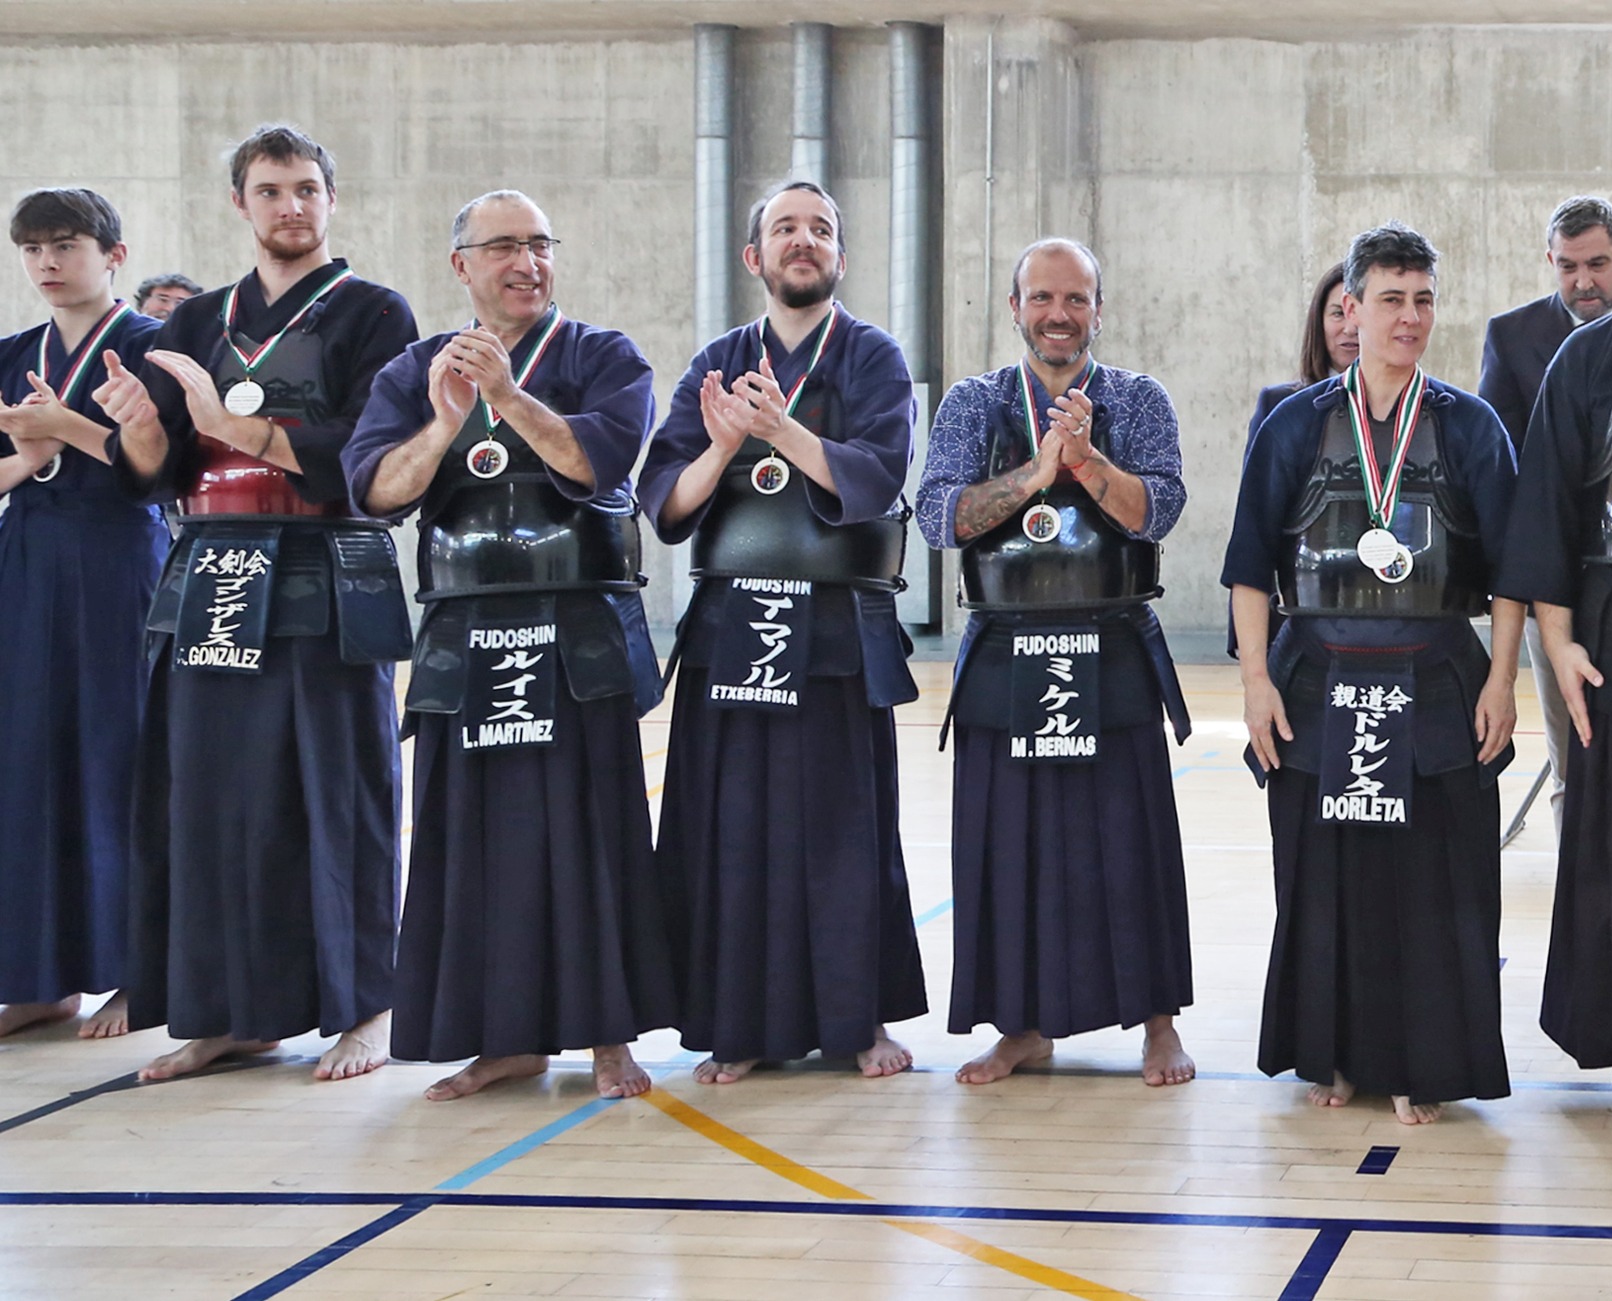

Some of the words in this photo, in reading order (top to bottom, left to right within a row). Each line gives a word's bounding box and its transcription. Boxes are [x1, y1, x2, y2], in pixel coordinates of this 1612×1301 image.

[193, 548, 272, 576] 大剣会
[469, 624, 556, 649] FUDOSHIN
[1013, 633, 1100, 656] FUDOSHIN
[176, 645, 262, 670] .GONZALEZ
[486, 650, 544, 721] ルイス
[710, 684, 799, 706] ETXEBERRIA
[1034, 657, 1081, 736] ミケル
[1342, 711, 1391, 797] ドルレタ
[1321, 795, 1406, 823] DORLETA
